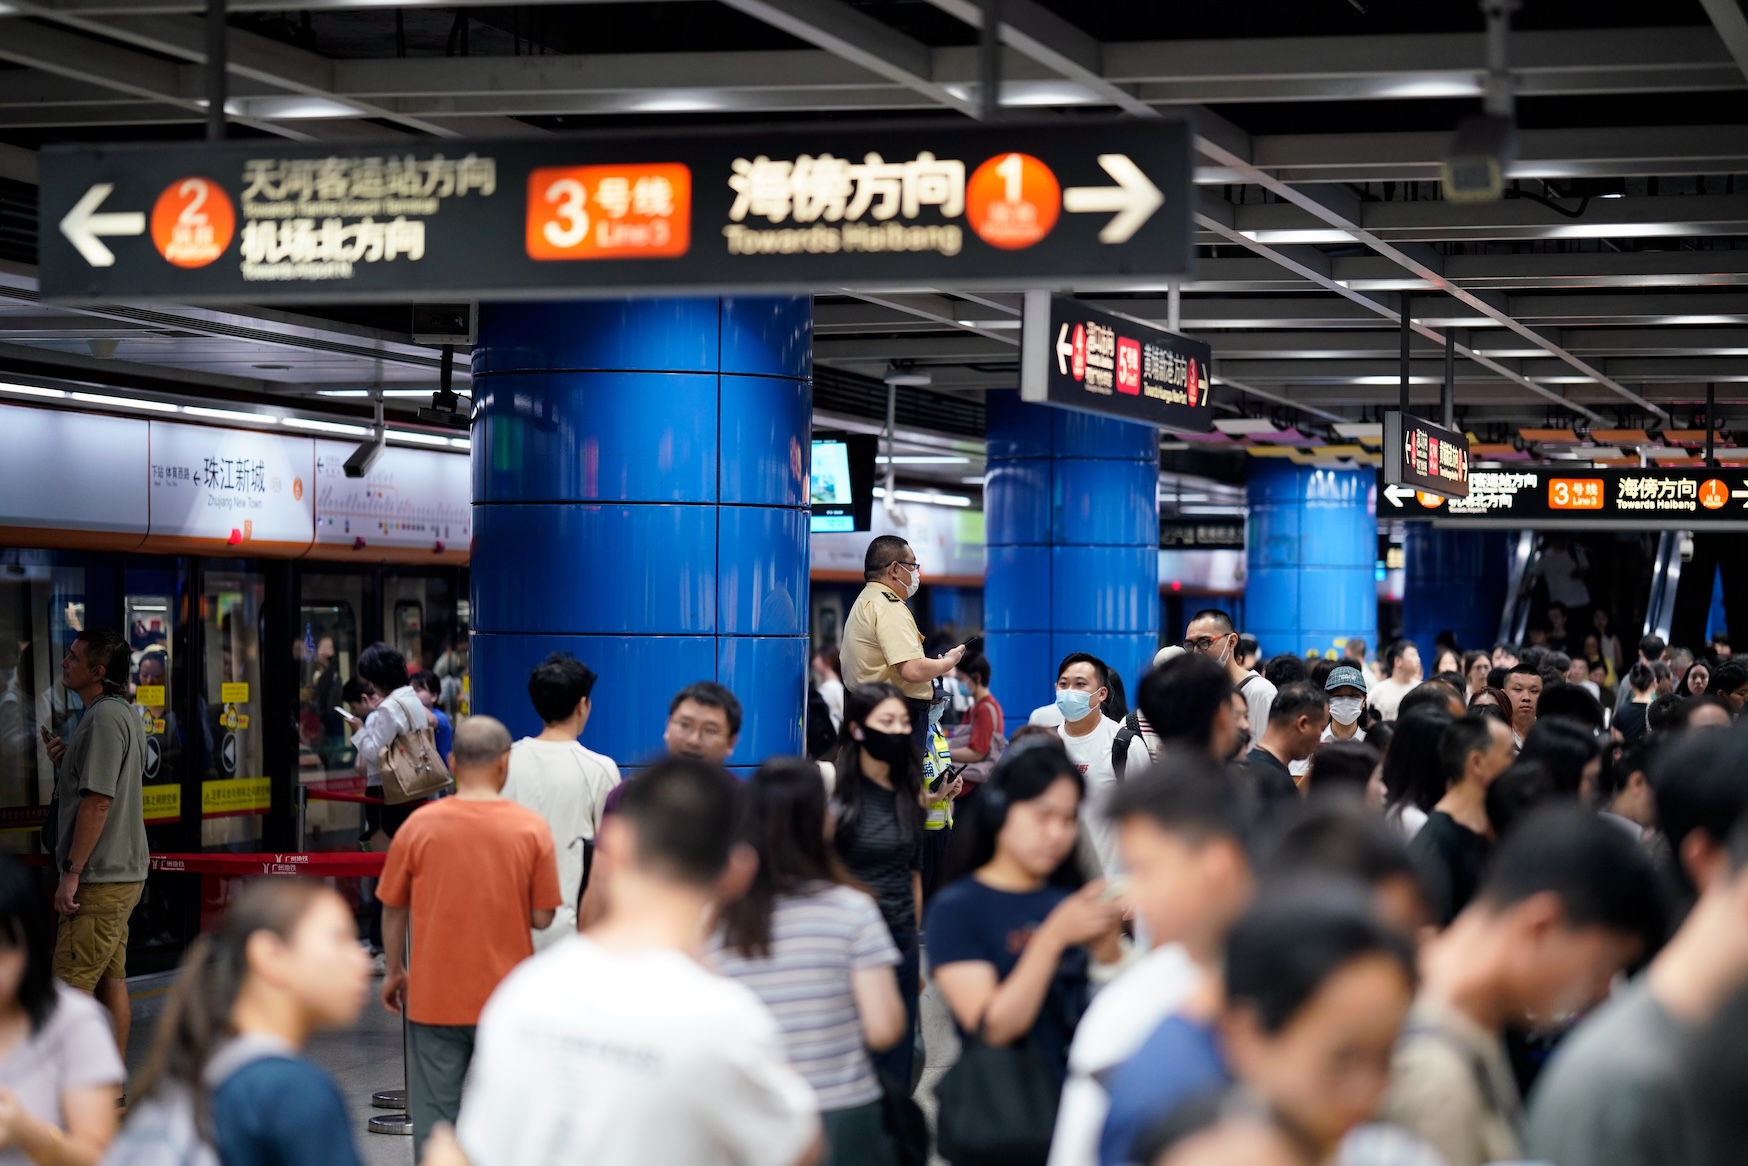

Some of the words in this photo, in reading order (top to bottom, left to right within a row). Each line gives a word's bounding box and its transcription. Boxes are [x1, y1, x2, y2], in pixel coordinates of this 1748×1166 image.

[241, 153, 496, 201] 天河客运站方向
[728, 151, 965, 222] 海傍方向
[995, 153, 1023, 204] 1
[179, 178, 208, 226] 2
[542, 178, 590, 248] 3
[593, 175, 675, 219] 号线
[240, 216, 425, 263] 机场北方向
[722, 222, 841, 254] Towards
[842, 219, 962, 256] Haibang
[1119, 345, 1128, 384] 5
[204, 456, 265, 492] 珠江新城
[1572, 482, 1598, 496] 号线
[1618, 477, 1697, 499] 海傍方向
[1709, 479, 1716, 495] 1
[208, 494, 232, 510] Zhujiang
[234, 496, 246, 508] New
[248, 497, 263, 509] Town
[1554, 482, 1570, 505] 3
[1616, 499, 1656, 509] Towards
[1657, 499, 1696, 511] Haibang
[161, 860, 185, 868] 广州地铁
[272, 863, 296, 872] 广州地铁
